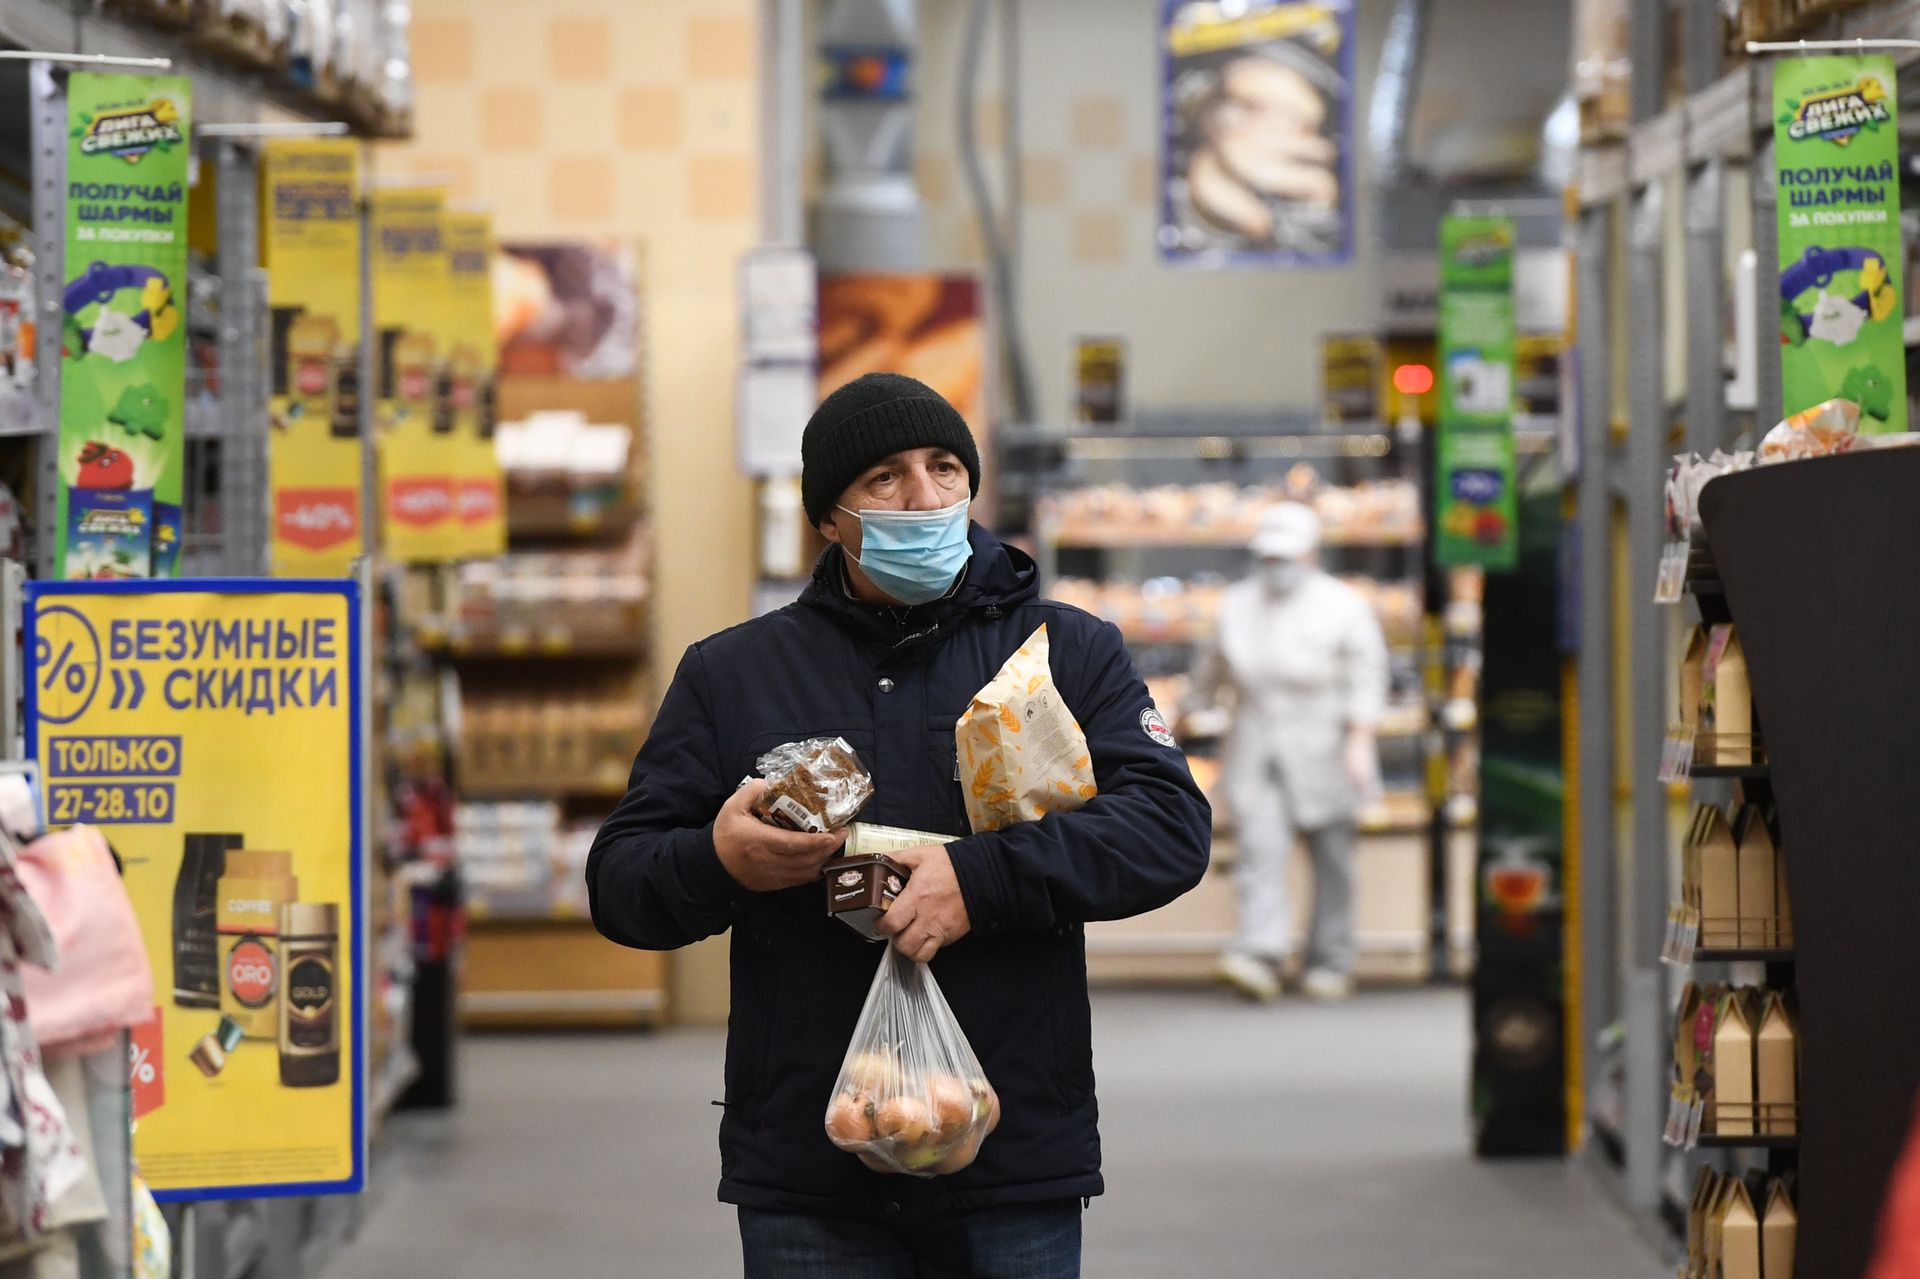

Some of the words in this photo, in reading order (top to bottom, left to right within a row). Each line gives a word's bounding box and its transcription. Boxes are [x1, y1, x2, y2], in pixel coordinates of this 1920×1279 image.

[1806, 95, 1864, 117] ЛИГА
[1789, 104, 1888, 138] СВЕЖИХ
[1780, 159, 1893, 186] ПОЛУЧАЙ
[69, 181, 183, 202] ПОЛУЧАЙ
[1790, 187, 1885, 207] ШАРМЫ
[78, 204, 174, 223] ШАРМЫ
[1789, 212, 1810, 227] ЗА
[1813, 210, 1888, 225] ПОКУПКИ
[76, 226, 96, 241] ЗА
[99, 227, 174, 242] ПОКУПКИ
[110, 618, 336, 661] БЕЗУМНЫЕ
[164, 667, 337, 715] СКИДКИ
[54, 739, 177, 772] ТОЛЬКО
[54, 787, 169, 819] 27-28.10
[228, 900, 273, 913] COFFEE
[231, 963, 272, 985] ORO
[291, 985, 328, 999] GOLD
